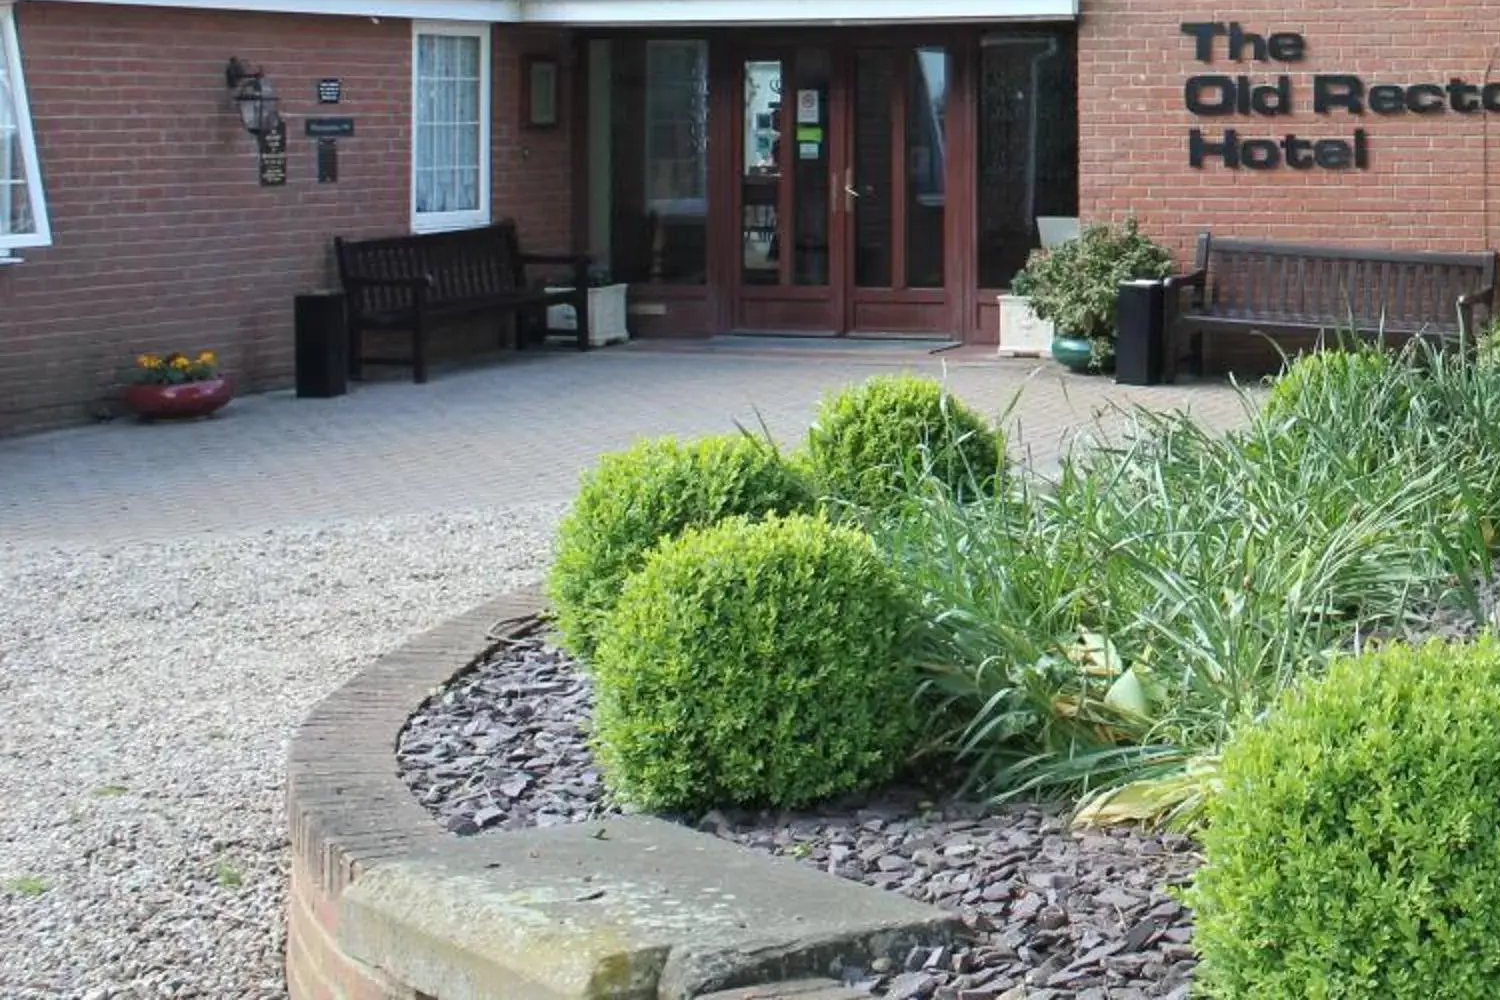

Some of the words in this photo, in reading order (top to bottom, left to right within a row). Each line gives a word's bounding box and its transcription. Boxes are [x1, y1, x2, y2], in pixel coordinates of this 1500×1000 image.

[1181, 21, 1307, 63] The
[1184, 73, 1291, 117] Old
[1188, 127, 1369, 170] Hotel
